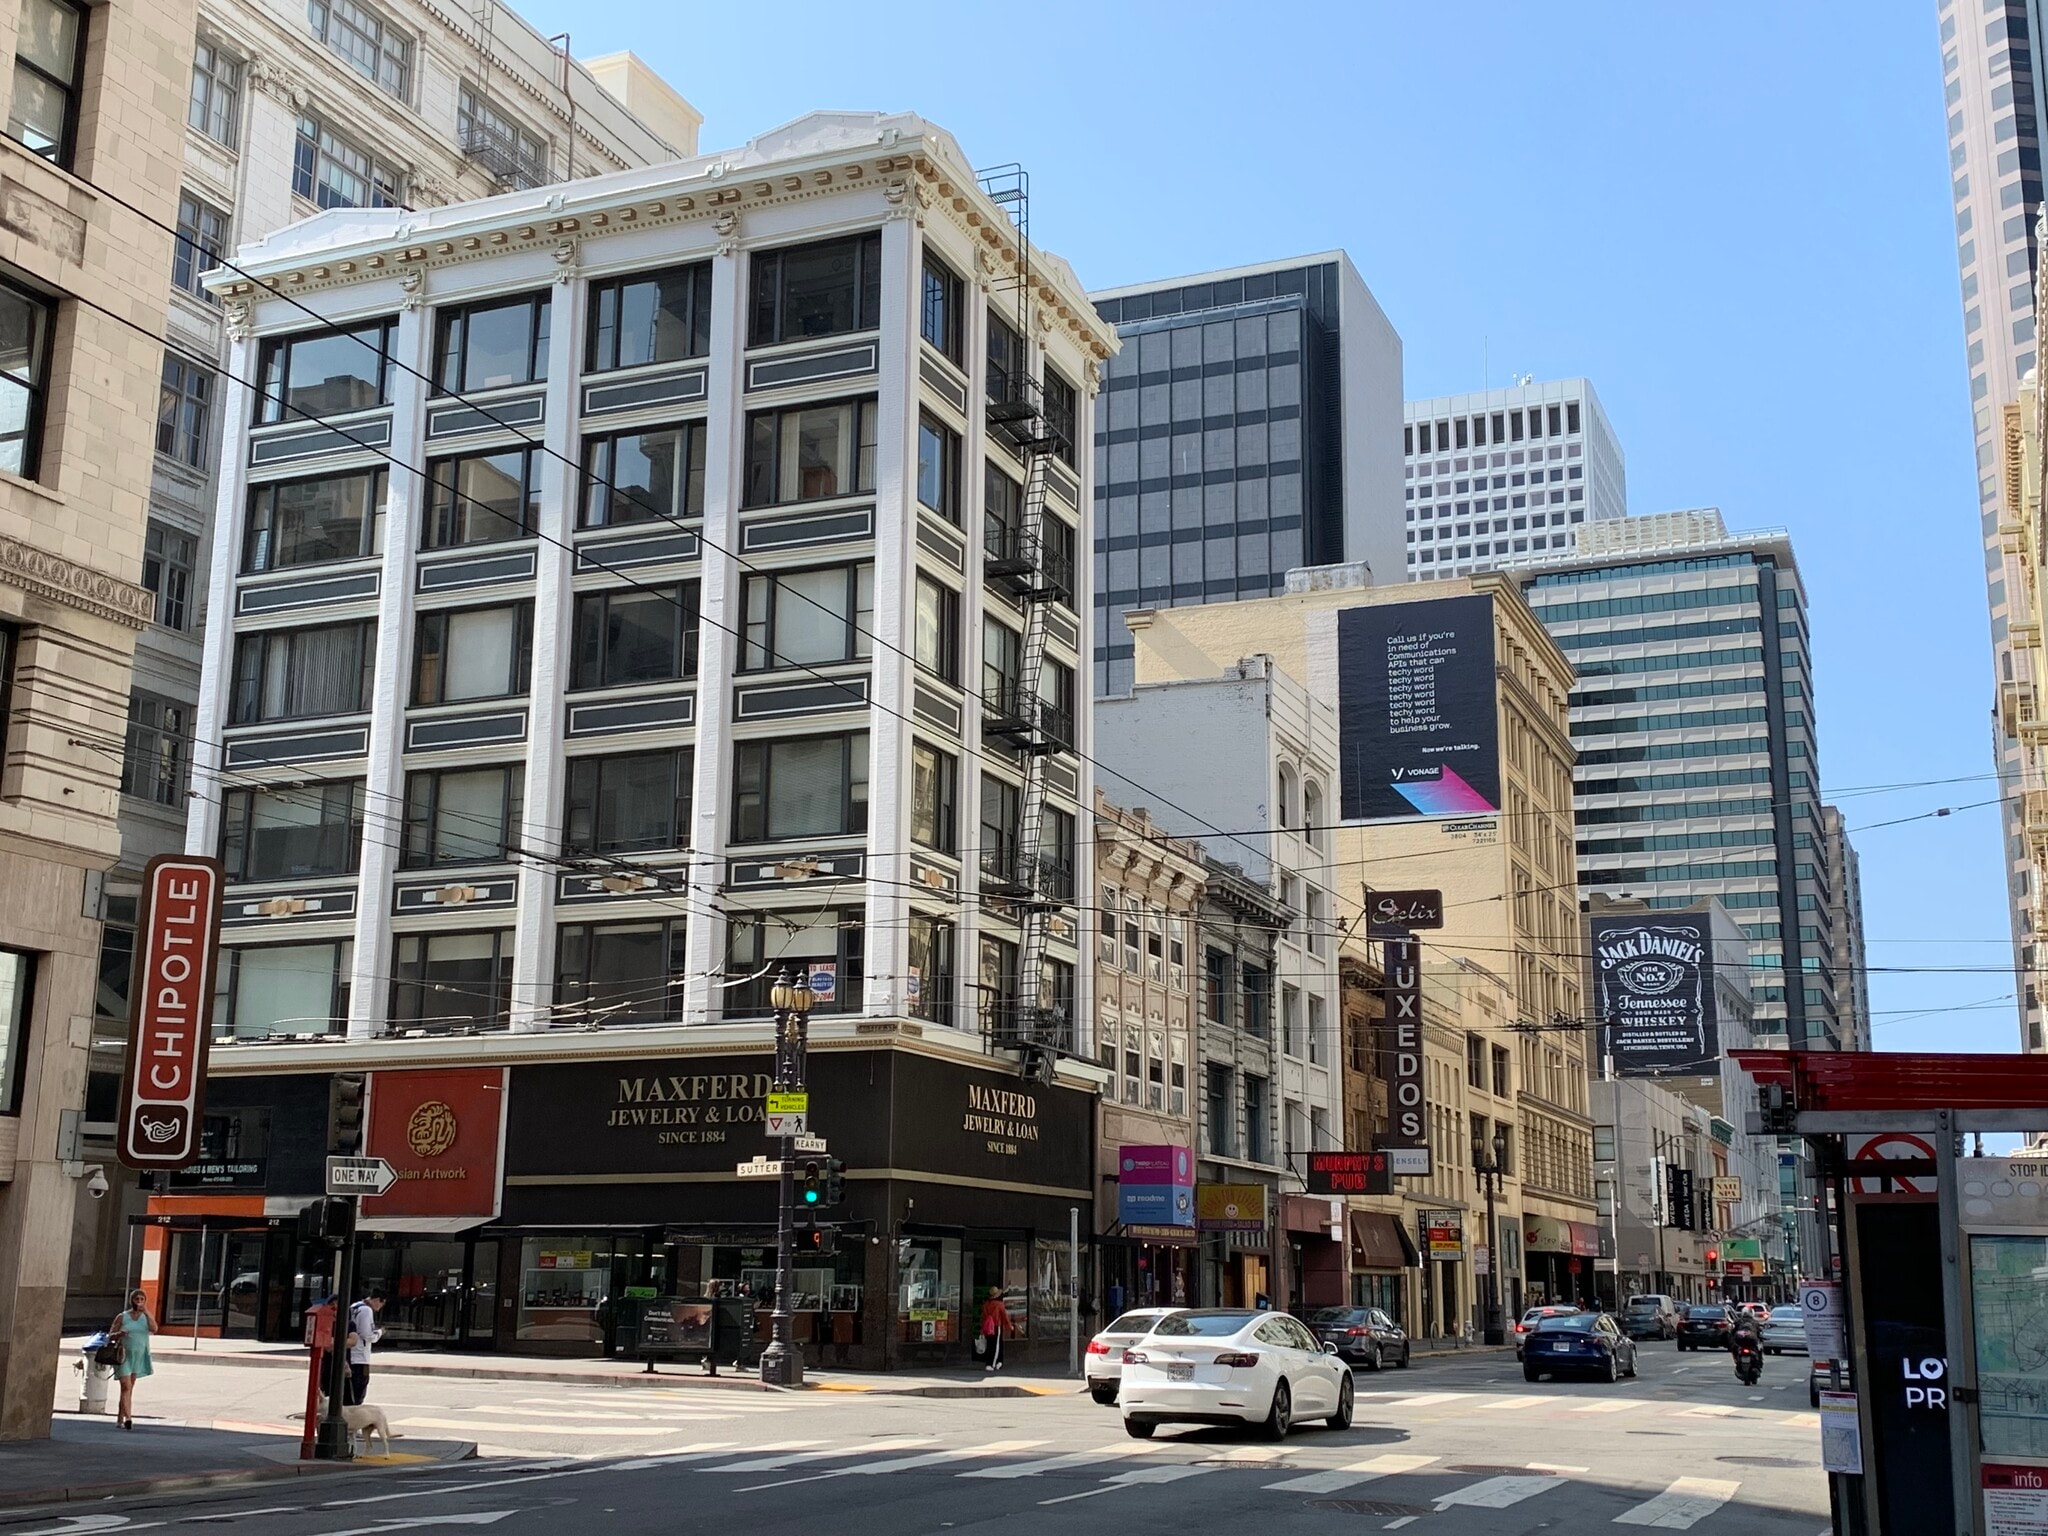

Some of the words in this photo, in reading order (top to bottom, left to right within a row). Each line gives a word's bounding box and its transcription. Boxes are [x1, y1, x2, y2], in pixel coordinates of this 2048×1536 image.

[1387, 636, 1404, 644] Call
[1419, 633, 1426, 641] if
[1428, 631, 1455, 642] you're
[1398, 643, 1418, 651] need
[1420, 641, 1429, 649] of
[1388, 648, 1456, 660] Communications
[1388, 660, 1407, 668] APIs
[1409, 658, 1427, 666] that
[1389, 668, 1412, 676] techy
[1414, 666, 1434, 674] word
[1389, 676, 1412, 685] techy
[1414, 674, 1434, 682] word
[1389, 684, 1412, 693] techy
[1414, 682, 1434, 690] word
[1389, 692, 1412, 701] techy
[1414, 690, 1434, 698] word
[1389, 700, 1412, 709] techy
[1415, 698, 1435, 706] word
[1390, 708, 1412, 717] techy
[1415, 706, 1435, 714] word
[1390, 718, 1399, 726] to
[1401, 716, 1420, 725] help
[1422, 714, 1441, 723] your
[1390, 724, 1428, 734] business
[1408, 767, 1439, 776] VONAGE
[1598, 938, 1640, 969] JACK
[1639, 932, 1705, 967] DANIEL'S
[1635, 972, 1666, 982] No.7
[150, 878, 199, 1090] CHIPOTLE
[1618, 995, 1687, 1009] Tennessee
[1621, 1016, 1687, 1027] WHISKEY
[1396, 937, 1420, 1136] TUXEDOS
[618, 1073, 773, 1103] MAXFERD
[969, 1084, 1036, 1119] MAXFERD
[607, 1107, 700, 1126] JEWELRY
[705, 1106, 720, 1123] &
[725, 1106, 767, 1123] LOA
[963, 1114, 1006, 1135] JEWELRY
[1007, 1121, 1014, 1137] &
[1016, 1122, 1039, 1140] LOAN
[658, 1131, 697, 1144] SINCE
[701, 1130, 726, 1143] 1884
[795, 1139, 825, 1150] KEARNY
[987, 1141, 1005, 1154] SINCE
[206, 1165, 224, 1174] MEN'S
[227, 1164, 258, 1174] TAILORING
[740, 1164, 778, 1174] SUTTER
[1313, 1155, 1384, 1171] MURPHYS
[334, 1169, 354, 1183] ONE
[358, 1170, 377, 1183] WAY
[396, 1168, 420, 1180] sian
[423, 1167, 466, 1180] Artwork
[2010, 1164, 2037, 1177] STOP
[1331, 1173, 1367, 1189] PUB
[1419, 1211, 1427, 1248] NOTARY
[373, 1232, 385, 1240] 210
[1813, 1296, 1820, 1305] 8
[1906, 1387, 1946, 1409] PR
[2014, 1471, 2042, 1488] info
